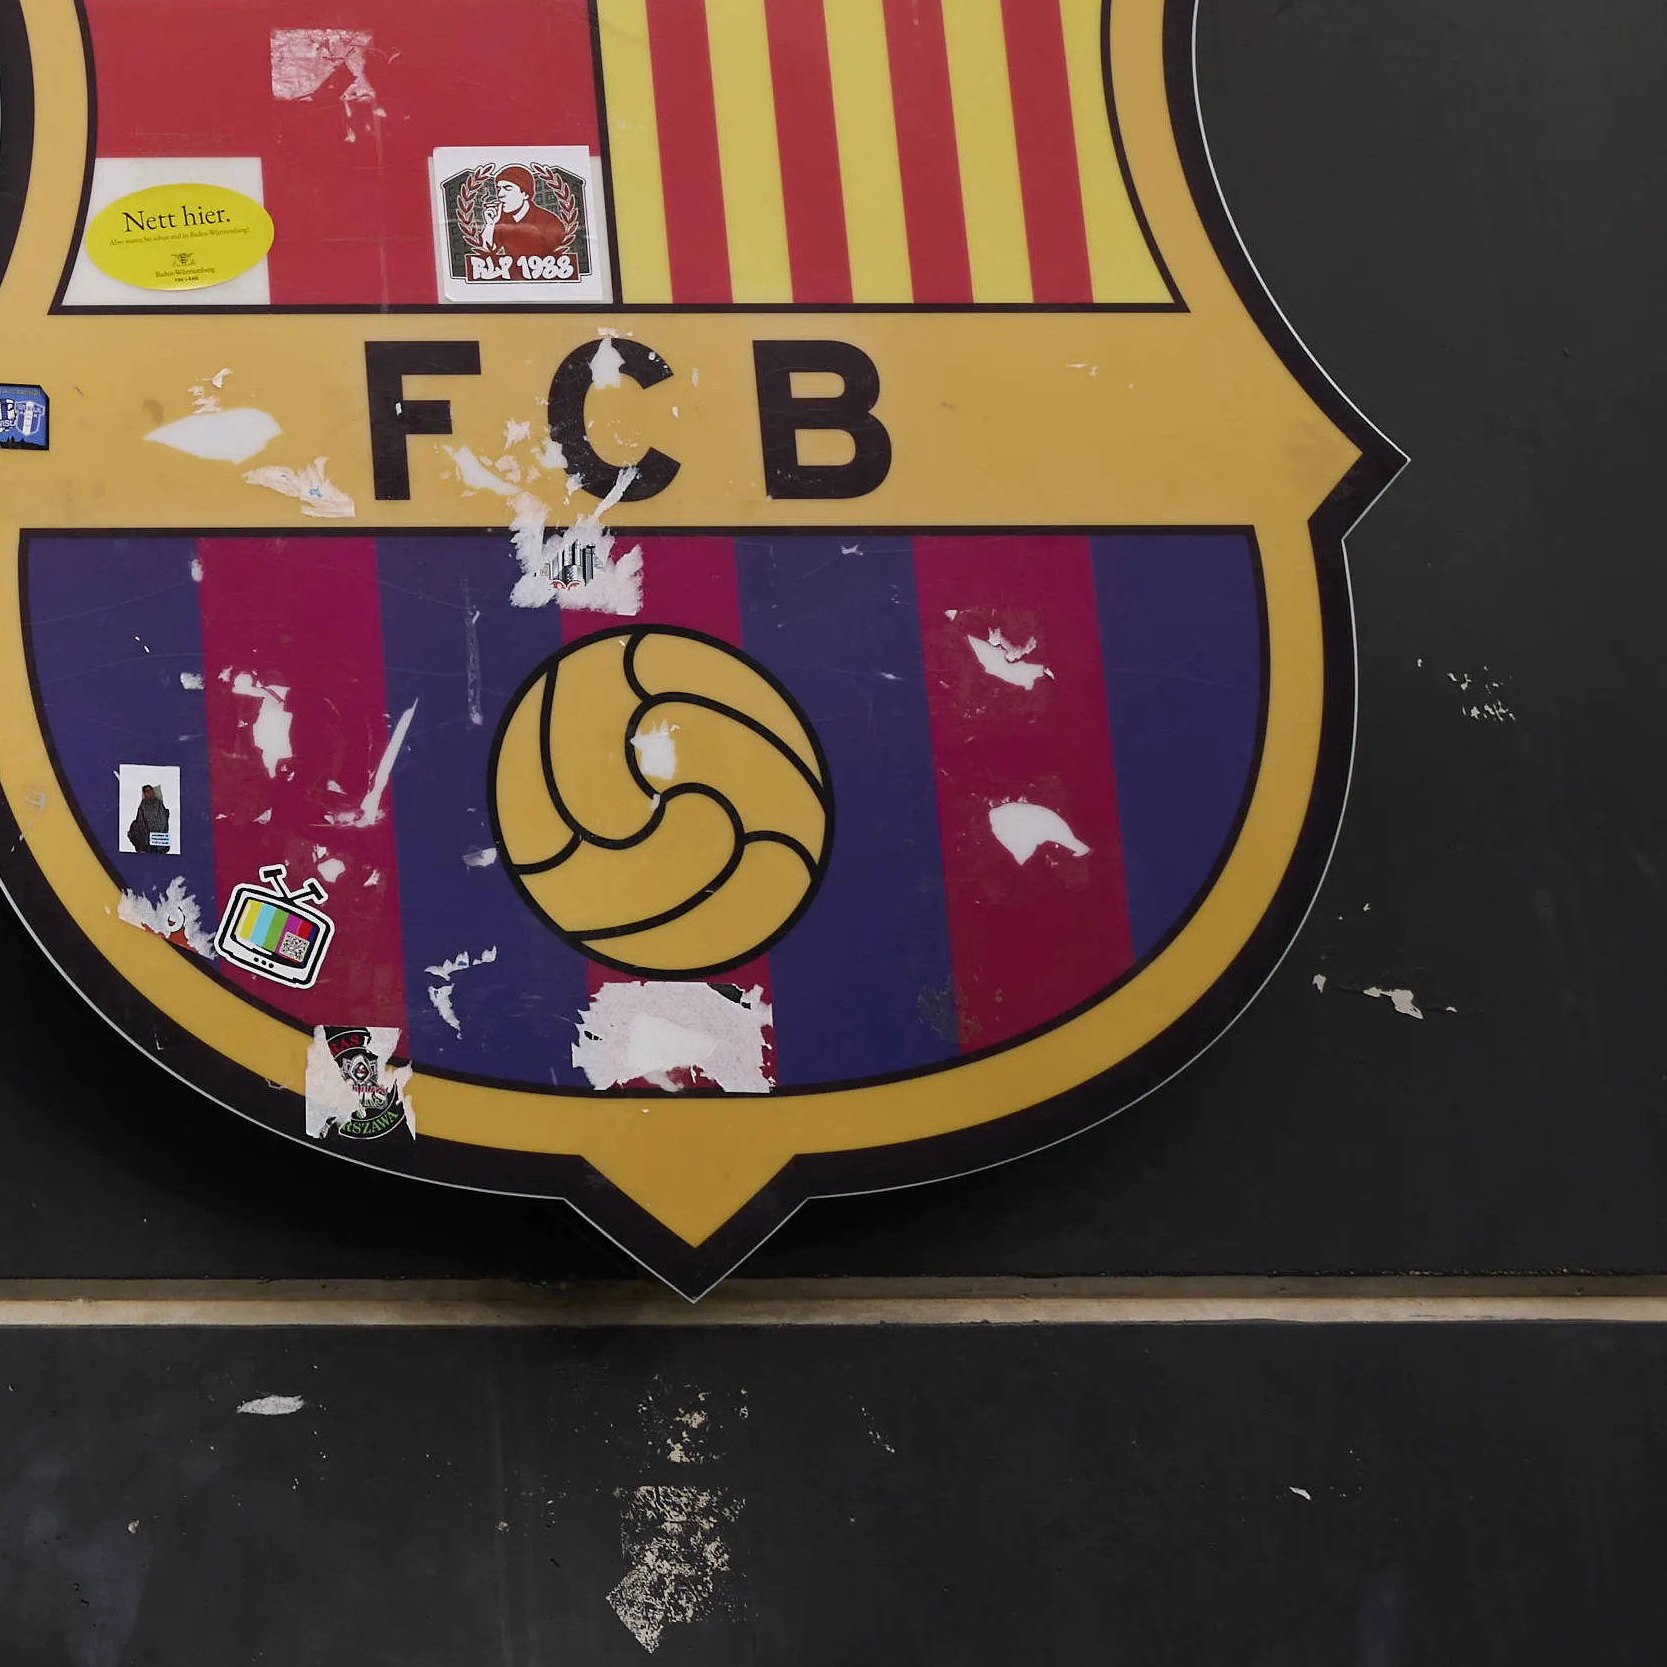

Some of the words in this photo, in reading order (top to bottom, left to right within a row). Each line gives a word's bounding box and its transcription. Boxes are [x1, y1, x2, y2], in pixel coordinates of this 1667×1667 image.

[122, 210, 178, 232] Nett
[182, 206, 231, 227] hier.
[470, 255, 513, 280] RLP
[516, 255, 574, 280] 1988
[342, 1110, 399, 1134] RSZAWA
